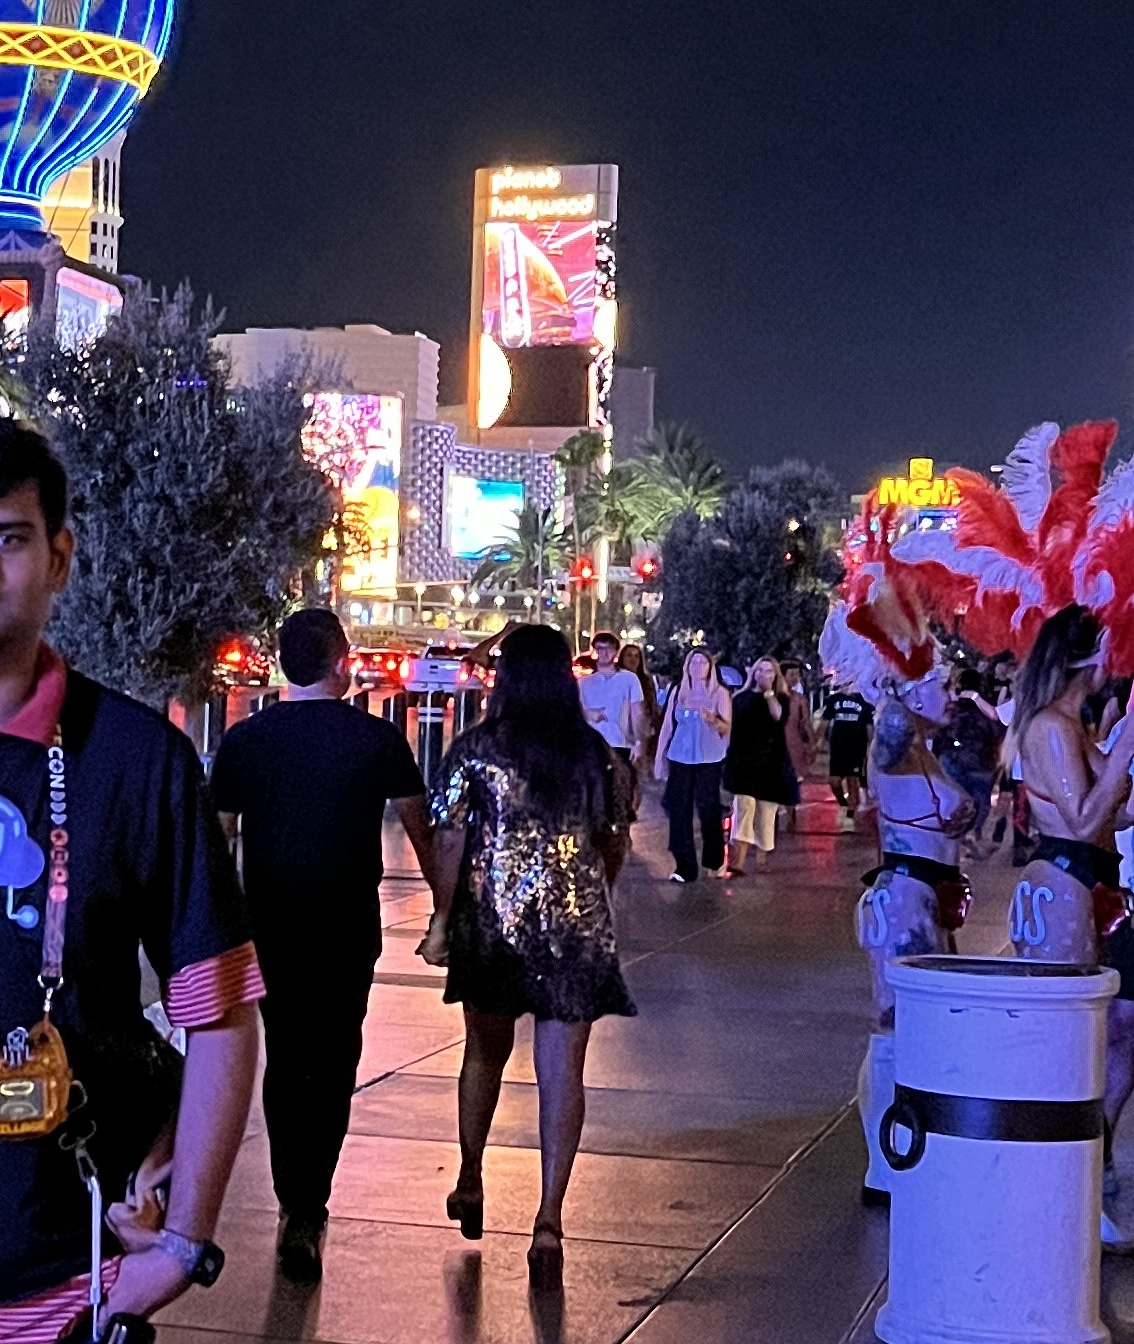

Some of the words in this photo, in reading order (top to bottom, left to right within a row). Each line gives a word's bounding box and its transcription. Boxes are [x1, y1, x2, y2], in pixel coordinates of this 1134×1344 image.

[491, 165, 562, 195] planet
[491, 193, 596, 221] hollywood
[878, 478, 960, 506] MGM
